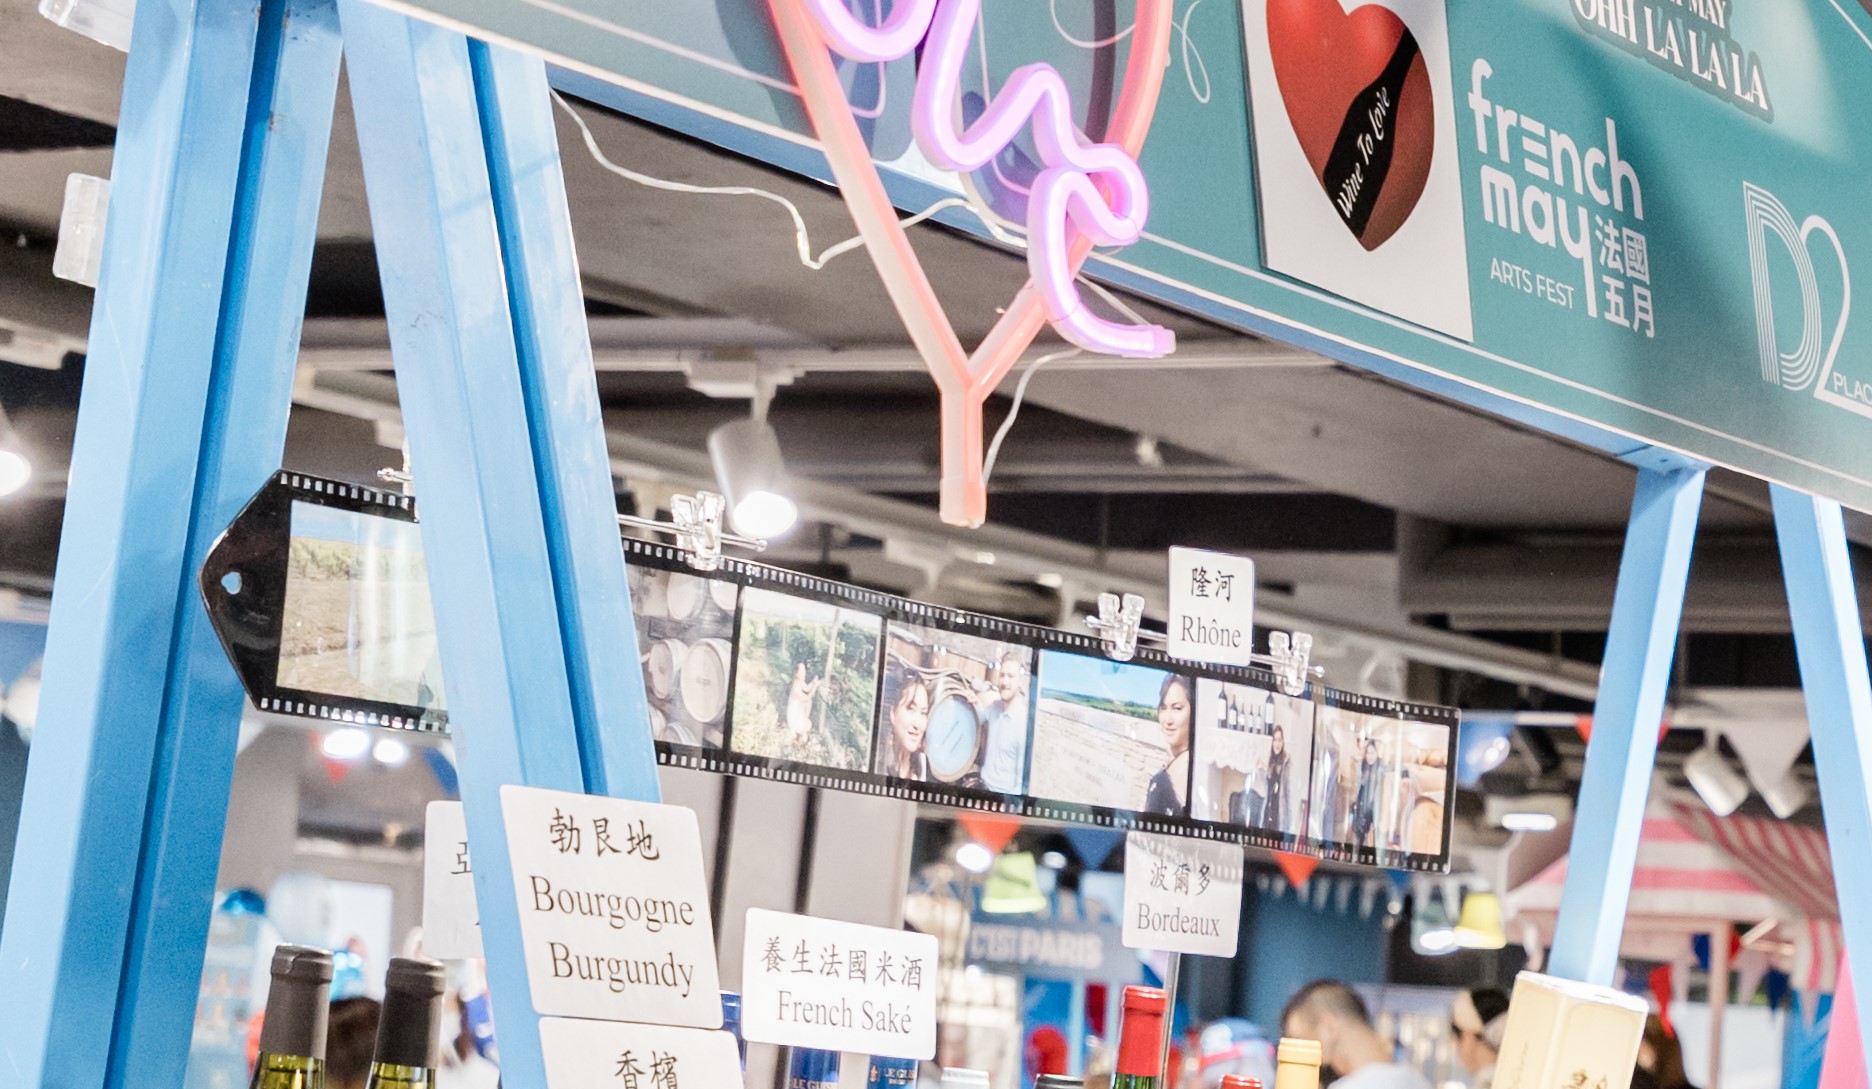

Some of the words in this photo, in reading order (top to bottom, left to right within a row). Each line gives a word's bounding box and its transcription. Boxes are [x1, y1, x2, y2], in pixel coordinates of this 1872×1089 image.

[1644, 6, 1684, 68] LA
[1688, 29, 1728, 90] LA
[1731, 52, 1769, 112] LA
[1337, 162, 1364, 219] Wine
[1357, 133, 1374, 166] To
[1368, 86, 1390, 141] Love
[1467, 58, 1644, 220] french
[1480, 165, 1598, 318] may
[1595, 215, 1651, 286] 法國
[1490, 257, 1533, 296] ARTS
[1537, 273, 1575, 310] FEST
[1603, 275, 1656, 340] 五月
[1190, 566, 1235, 602] 隆河
[1180, 614, 1242, 649] Rhône
[549, 807, 660, 862] 勃艮地
[530, 874, 695, 932] Bourgogne
[1149, 861, 1212, 897] 波爾多
[1137, 903, 1221, 938] Bordeaux
[547, 941, 695, 998] Burgundy
[759, 936, 923, 993] 養生法國米酒
[777, 989, 854, 1030] French
[861, 1000, 914, 1035] Saké
